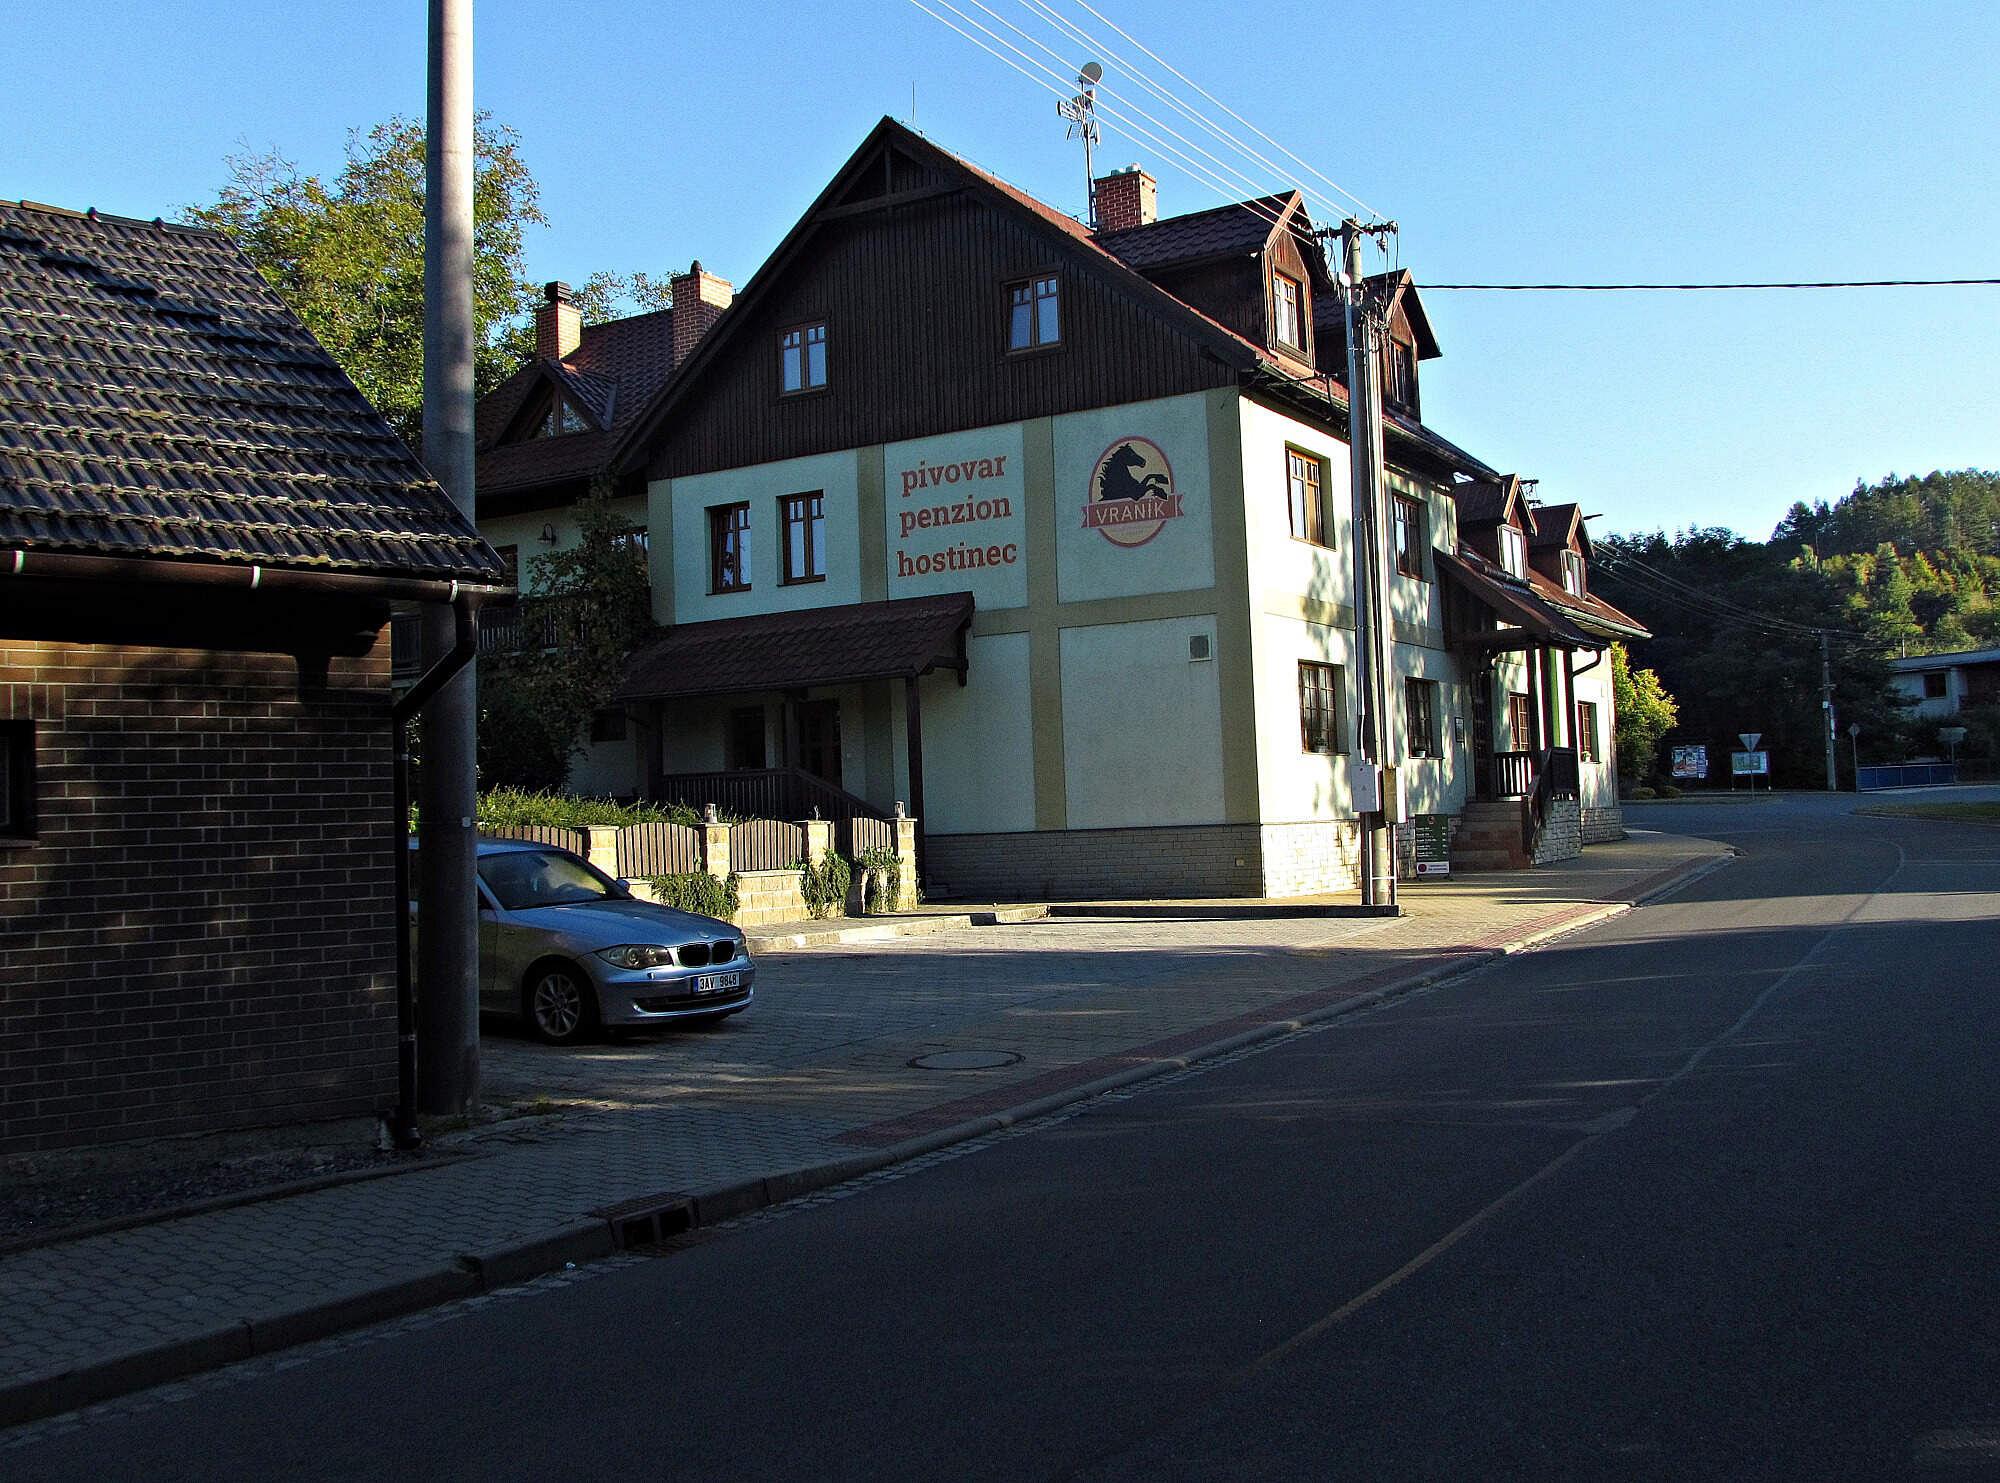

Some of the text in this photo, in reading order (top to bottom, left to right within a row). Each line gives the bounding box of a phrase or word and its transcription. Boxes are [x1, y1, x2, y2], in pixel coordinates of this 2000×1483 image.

[901, 456, 1007, 498] pivovar
[899, 494, 1012, 538] penzion
[1096, 499, 1165, 524] VRANÍK
[896, 541, 1017, 577] hostinec
